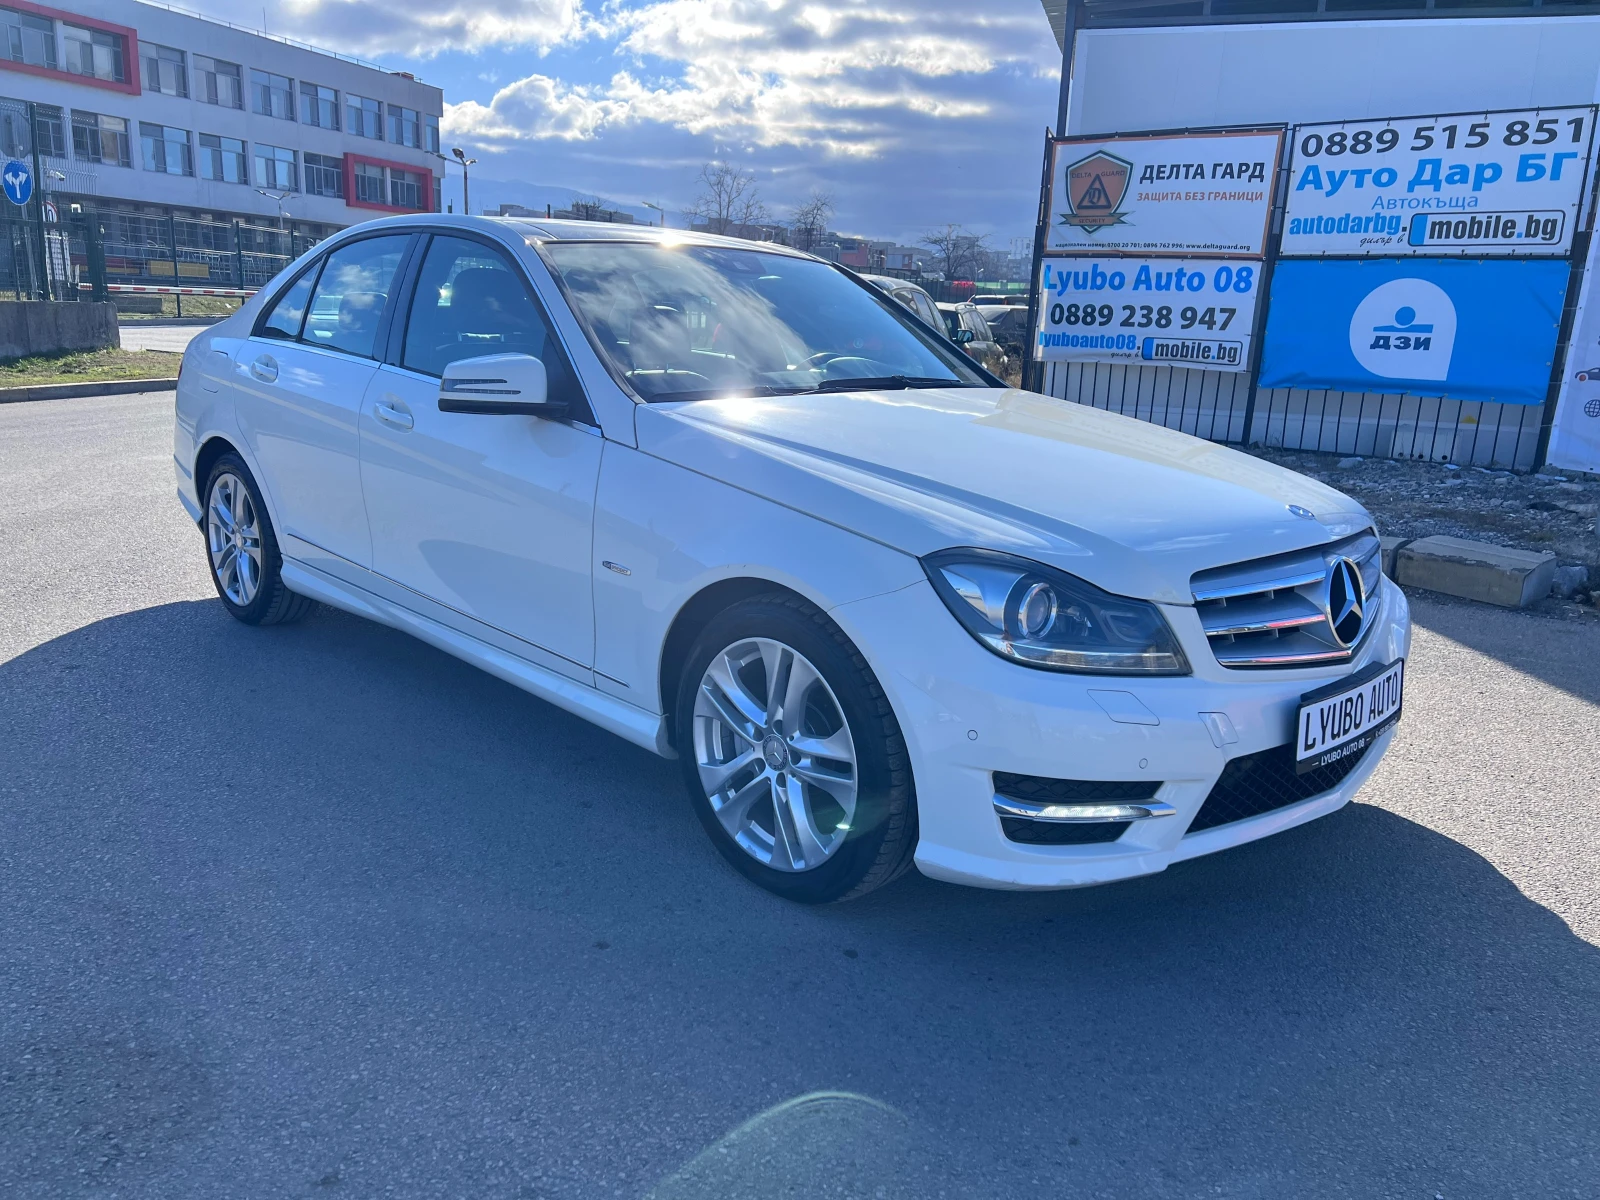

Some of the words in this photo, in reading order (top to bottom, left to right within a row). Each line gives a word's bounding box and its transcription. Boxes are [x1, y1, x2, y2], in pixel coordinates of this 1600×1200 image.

[1301, 129, 1399, 157] 0889
[1409, 123, 1490, 151] 515
[1502, 116, 1584, 147] 851
[1139, 164, 1205, 184] ДЕЛТА
[1211, 162, 1265, 183] ГАРД
[1296, 164, 1399, 198] Ауто
[1406, 157, 1503, 193] Дар
[1515, 151, 1579, 183] БГ
[1136, 191, 1183, 202] ЗАЩИТА
[1184, 191, 1205, 201] БЕЗ
[1208, 191, 1264, 202] ГРАНИЦИ
[1371, 195, 1479, 210] Автокъща
[1428, 215, 1558, 241] mobile.bg
[1186, 243, 1251, 251] www.deltaguard.org
[1044, 264, 1126, 297] Lyubo
[1132, 264, 1206, 292] Auto
[1213, 265, 1254, 294] 08
[1050, 303, 1114, 327] 0889
[1119, 305, 1172, 328] 238
[1180, 307, 1237, 331] 947
[1155, 342, 1238, 362] mobile.bg
[1370, 336, 1431, 350] ДЗИ
[1304, 692, 1363, 751] LYUBO
[1368, 671, 1398, 723] AUTO
[1321, 750, 1341, 766] LYUBO
[1342, 742, 1357, 757] AUTO
[1358, 738, 1364, 748] 08
